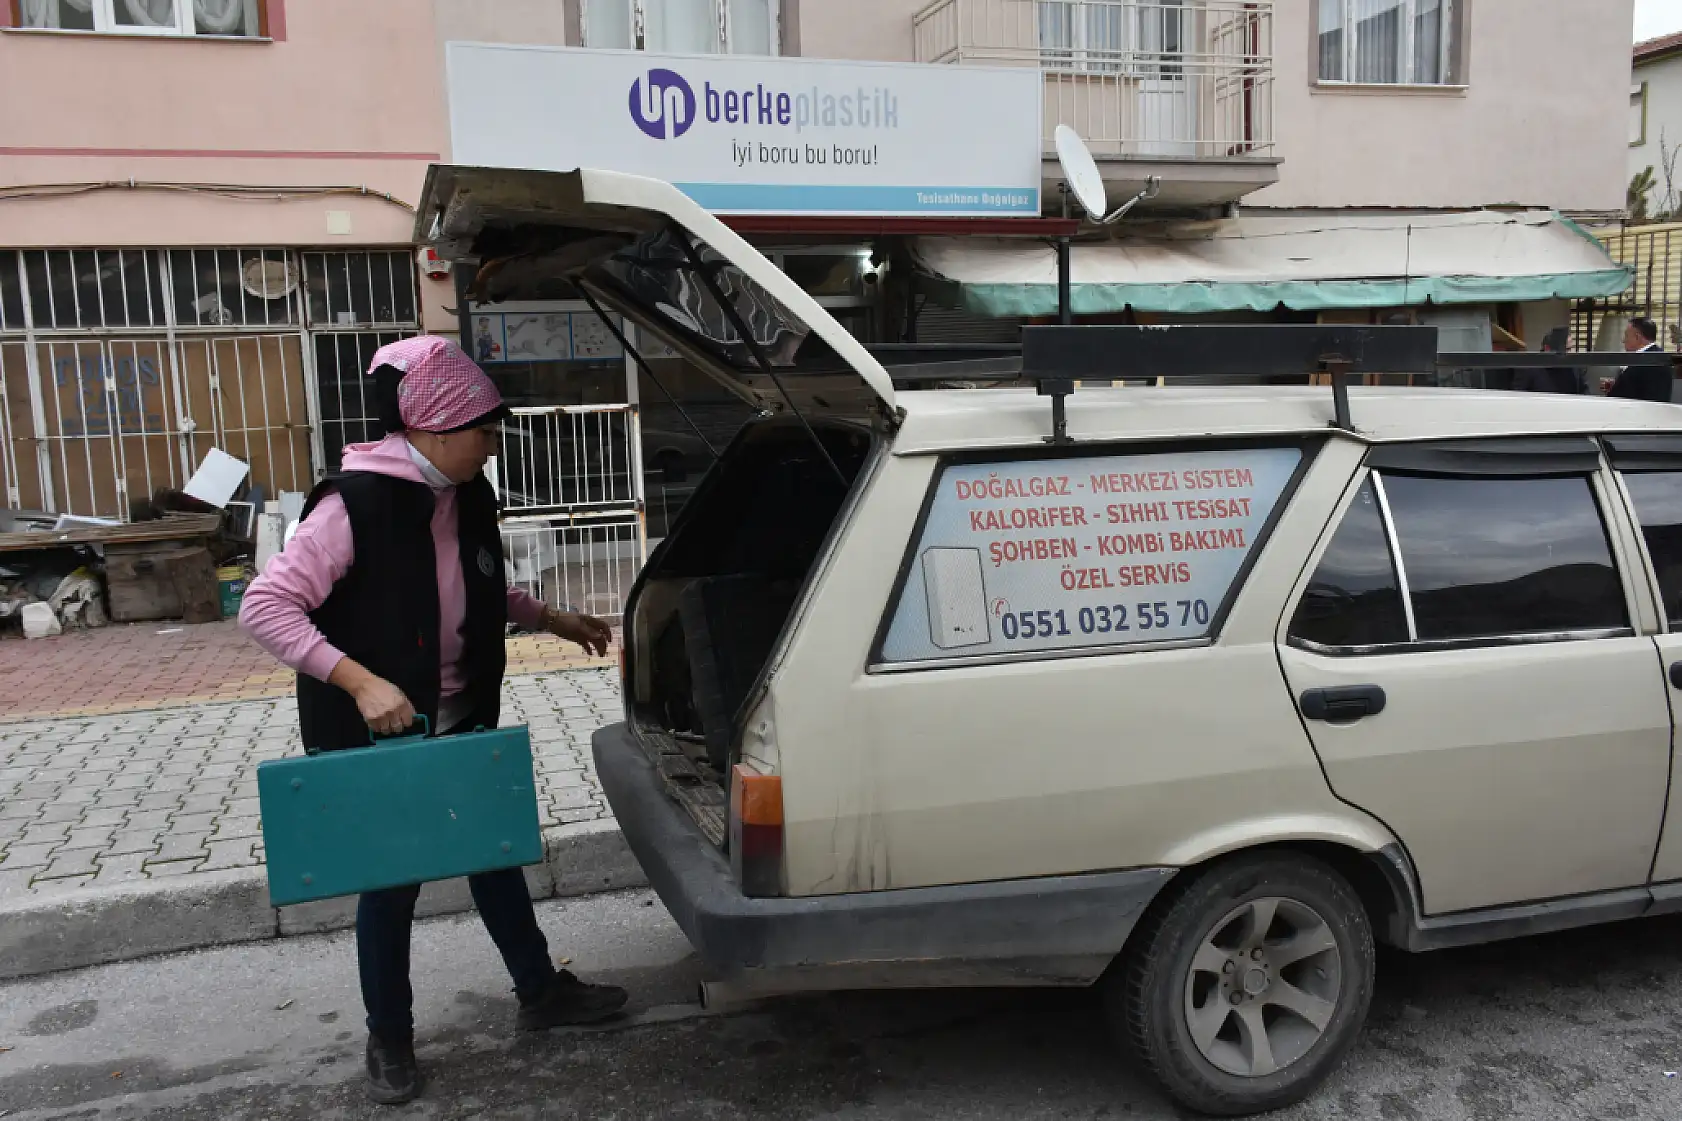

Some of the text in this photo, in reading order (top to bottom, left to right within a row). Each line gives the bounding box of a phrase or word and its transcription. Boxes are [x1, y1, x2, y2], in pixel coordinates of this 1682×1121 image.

[704, 81, 898, 134] berkeplastik
[759, 142, 799, 164] boru
[805, 143, 826, 165] bu
[833, 144, 878, 166] boru!
[955, 473, 1072, 500] DOĞALGAZ
[1107, 501, 1170, 525] SIHHI
[989, 537, 1078, 567] ŞOHBEN
[1170, 528, 1247, 550] BAKIMI
[1060, 564, 1115, 591] ÖZEL
[1001, 598, 1209, 640] 0551 032 55 70
